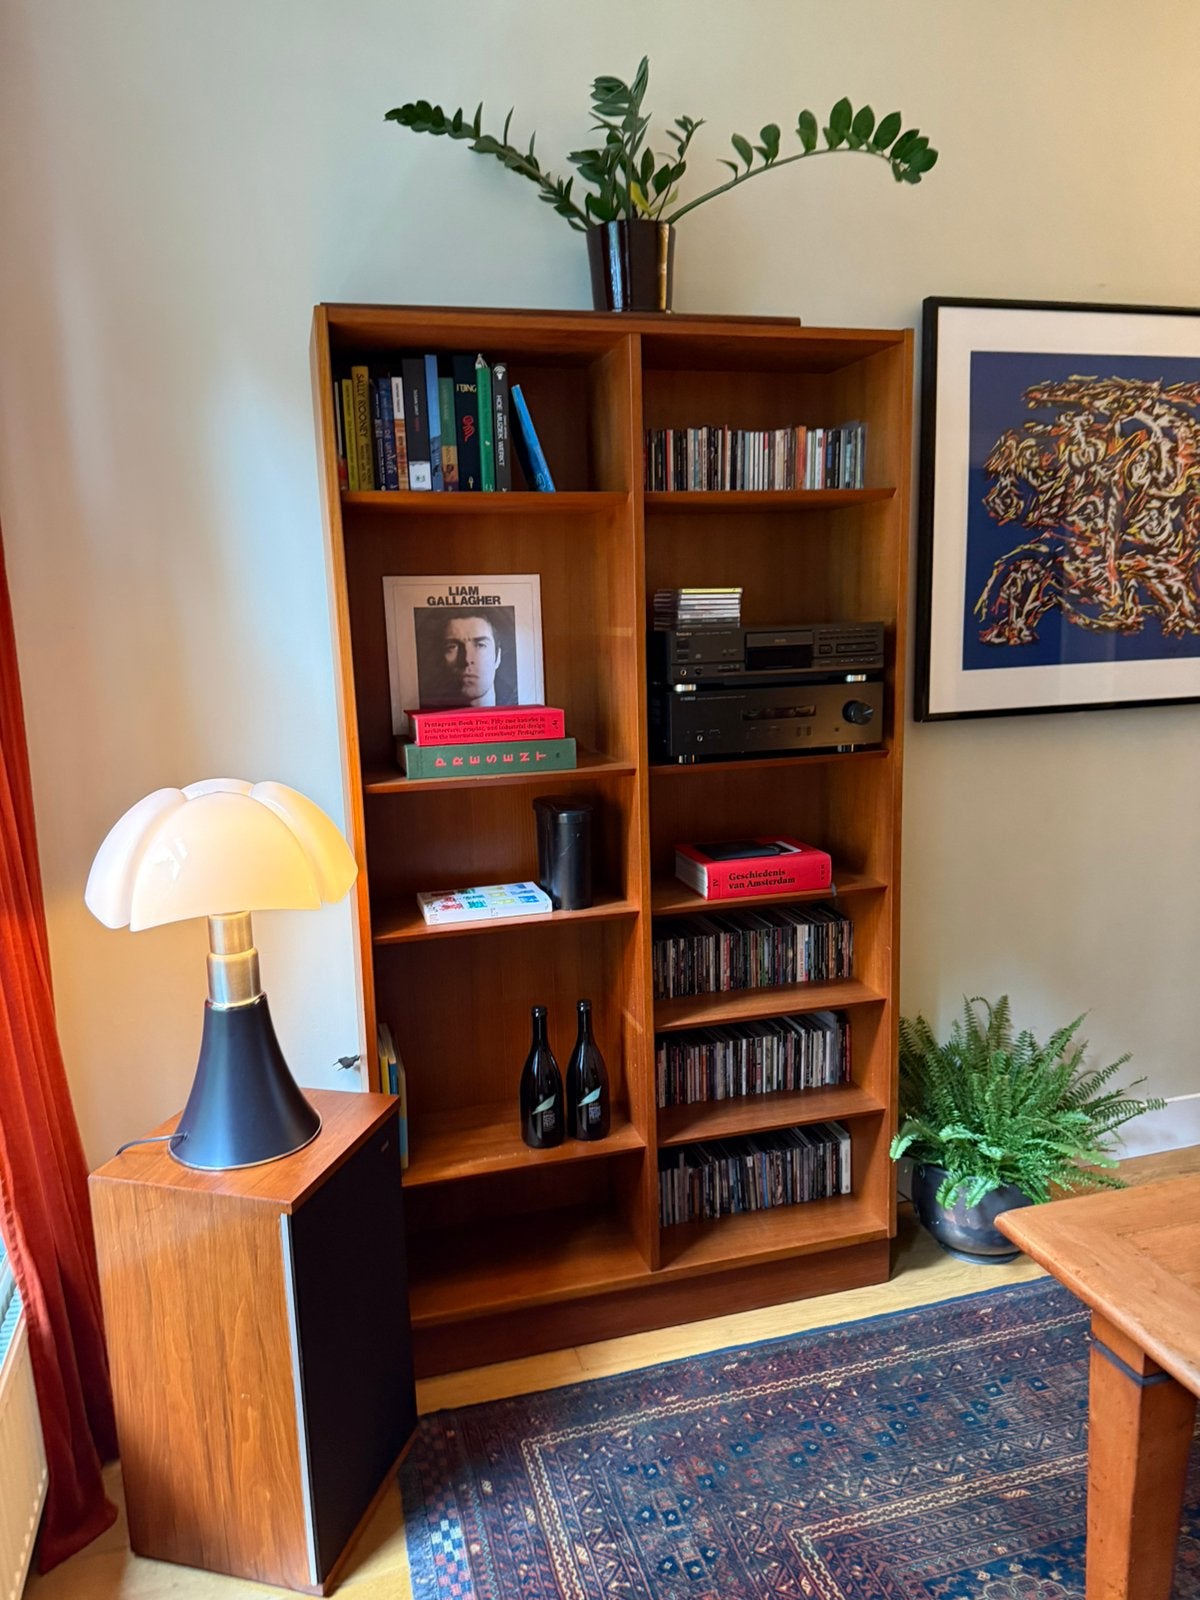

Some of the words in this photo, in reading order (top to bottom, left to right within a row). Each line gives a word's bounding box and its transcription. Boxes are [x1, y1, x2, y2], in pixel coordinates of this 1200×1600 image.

[356, 373, 365, 397] SALLY
[358, 400, 369, 438] ROONEY
[496, 412, 504, 440] MUZIEK
[448, 586, 479, 596] LIAM
[427, 595, 501, 606] GALLAGHER
[490, 717, 504, 725] Fifty
[434, 751, 548, 768] PRESENT
[728, 868, 786, 881] Geschiedenis
[728, 881, 745, 890] van
[746, 877, 796, 888] Amsterdam
